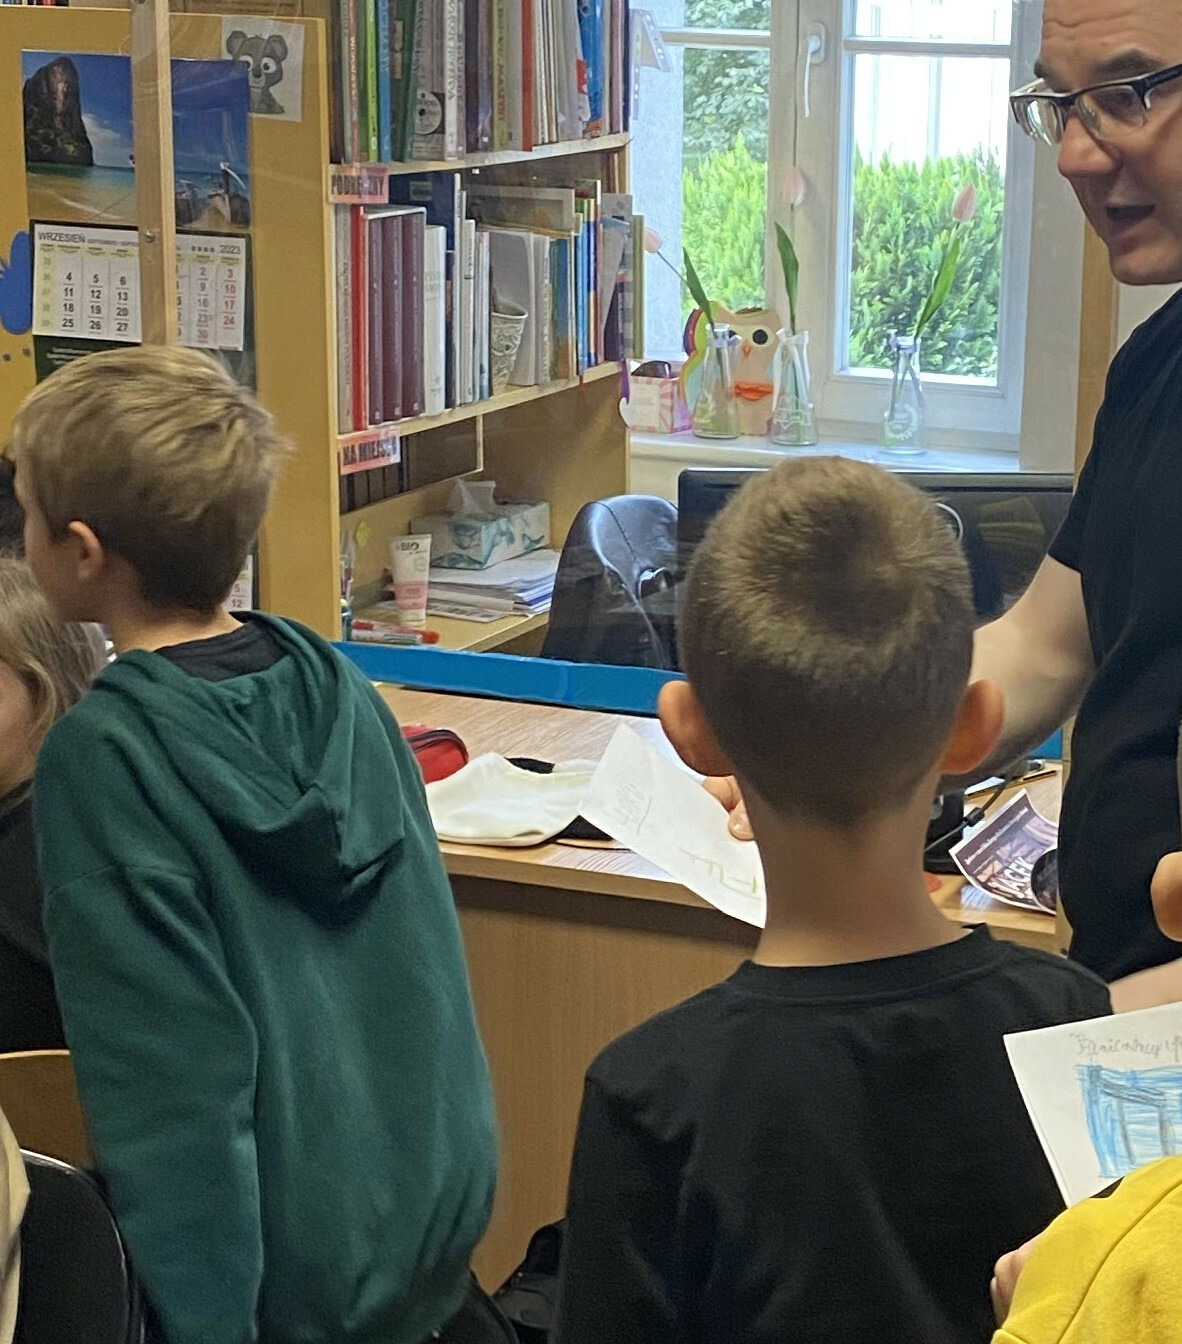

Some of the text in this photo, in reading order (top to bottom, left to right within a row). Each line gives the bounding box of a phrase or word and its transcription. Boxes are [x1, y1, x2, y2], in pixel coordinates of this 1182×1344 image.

[38, 232, 85, 243] WRZESIEŃ
[227, 269, 234, 278] 3
[65, 272, 72, 281] 4
[93, 274, 99, 284] 5
[120, 276, 126, 286] 6
[224, 284, 236, 294] 10
[63, 287, 74, 297] 11
[90, 289, 102, 299] 12
[117, 291, 128, 301] 13
[224, 300, 236, 310] 17
[63, 303, 74, 313] 18
[90, 305, 102, 315] 19
[116, 307, 129, 317] 20
[223, 316, 235, 326] 24
[62, 318, 74, 328] 25
[90, 320, 102, 330] 26
[116, 322, 128, 332] 27
[343, 444, 357, 466] NA
[232, 598, 243, 609] 12
